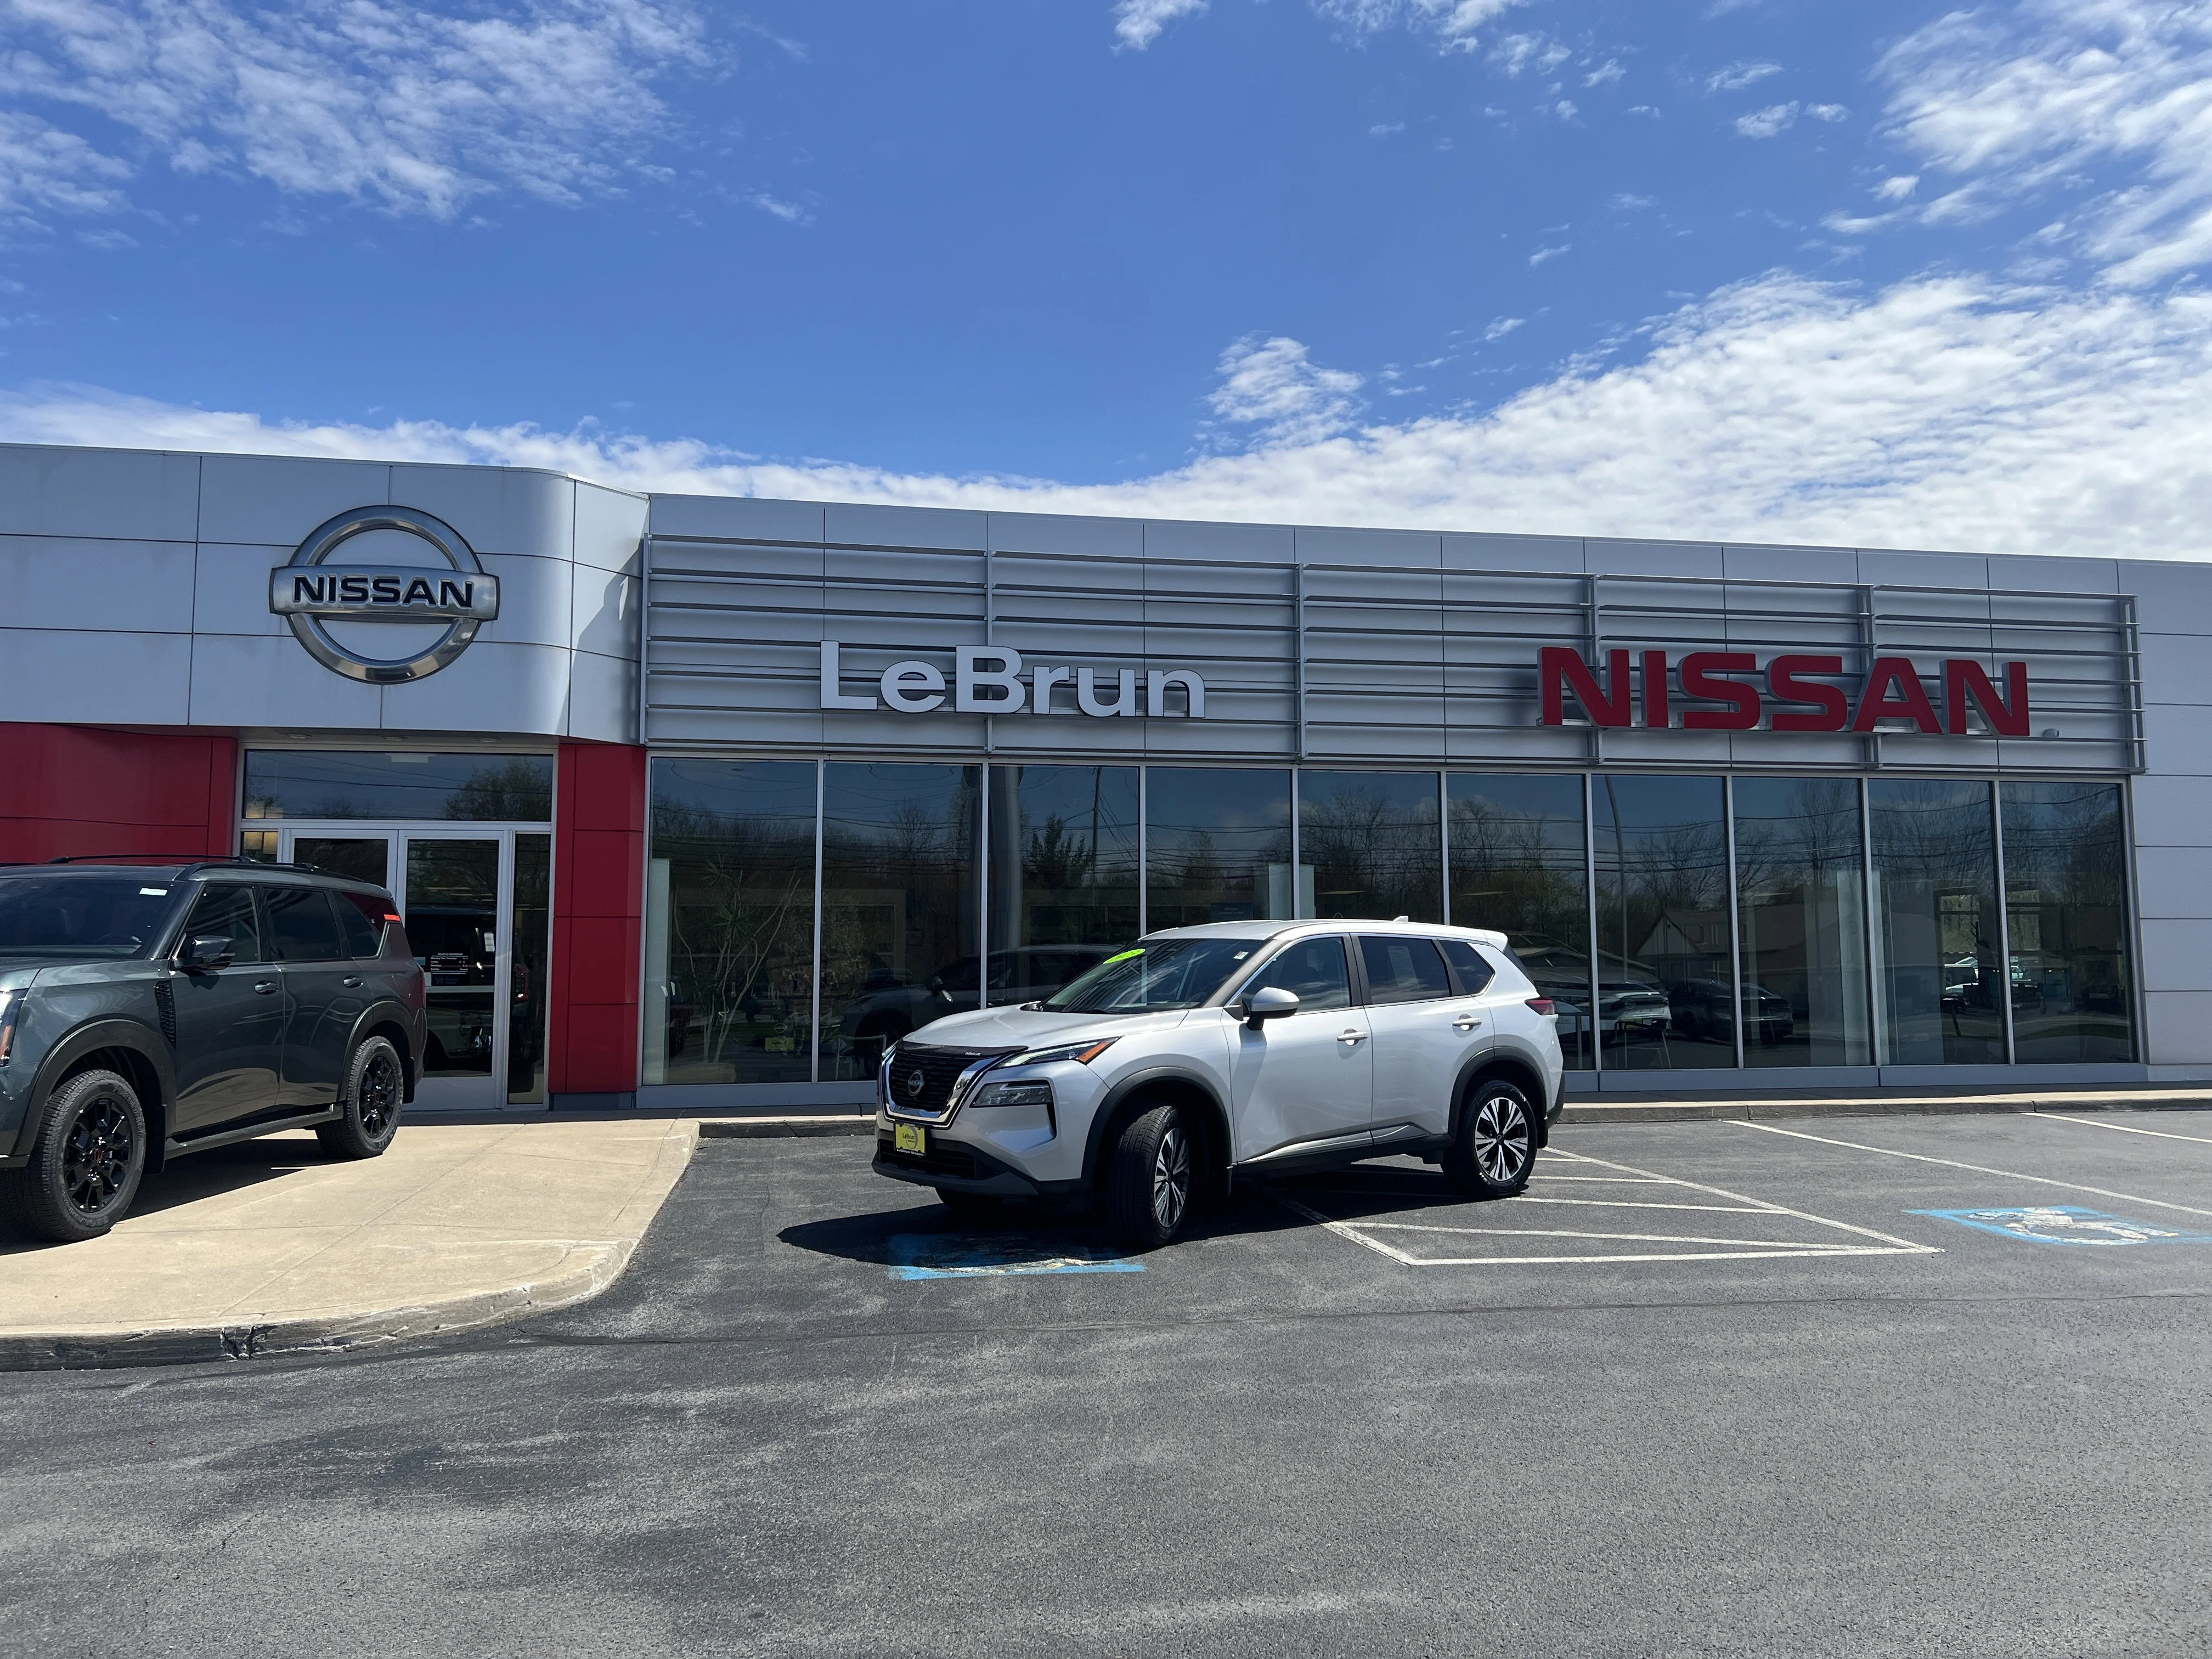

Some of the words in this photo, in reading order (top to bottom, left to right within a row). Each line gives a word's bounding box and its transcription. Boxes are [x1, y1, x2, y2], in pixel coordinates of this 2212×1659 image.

[292, 575, 473, 608] NISSAN
[820, 640, 1206, 719] LeBrun
[1537, 647, 2030, 737] NISSAN
